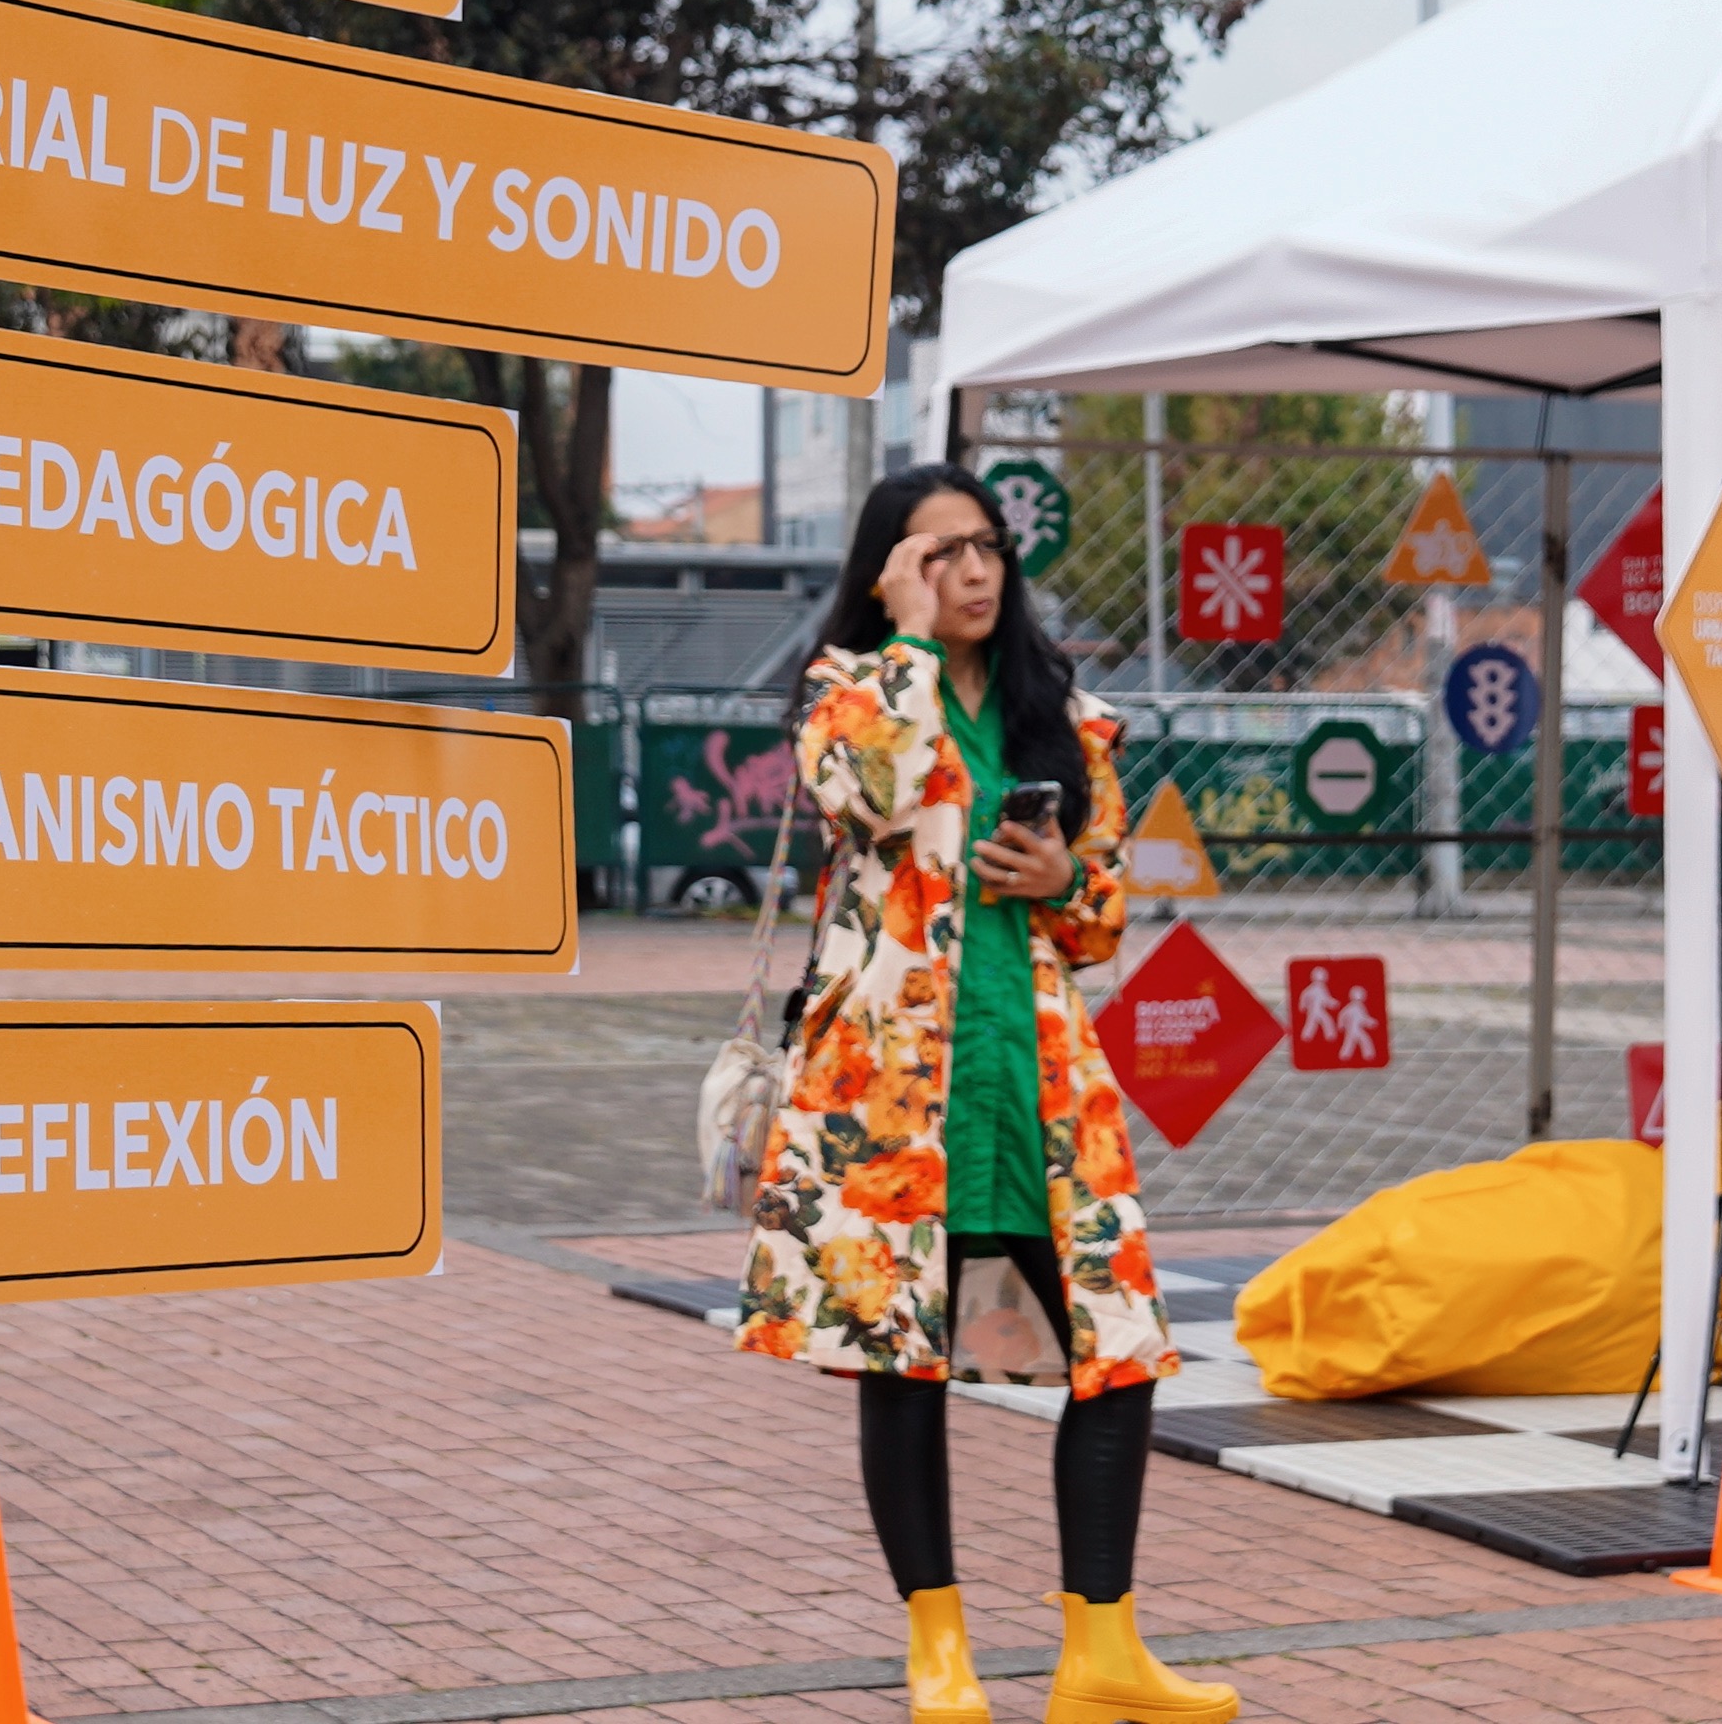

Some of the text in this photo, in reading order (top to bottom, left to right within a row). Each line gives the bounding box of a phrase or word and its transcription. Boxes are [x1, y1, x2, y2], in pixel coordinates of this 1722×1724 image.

[148, 105, 248, 208] DE
[268, 127, 407, 234] LUZ
[423, 154, 477, 242] Y
[487, 167, 782, 290] SONIDO
[267, 766, 509, 881] TÁCTICO
